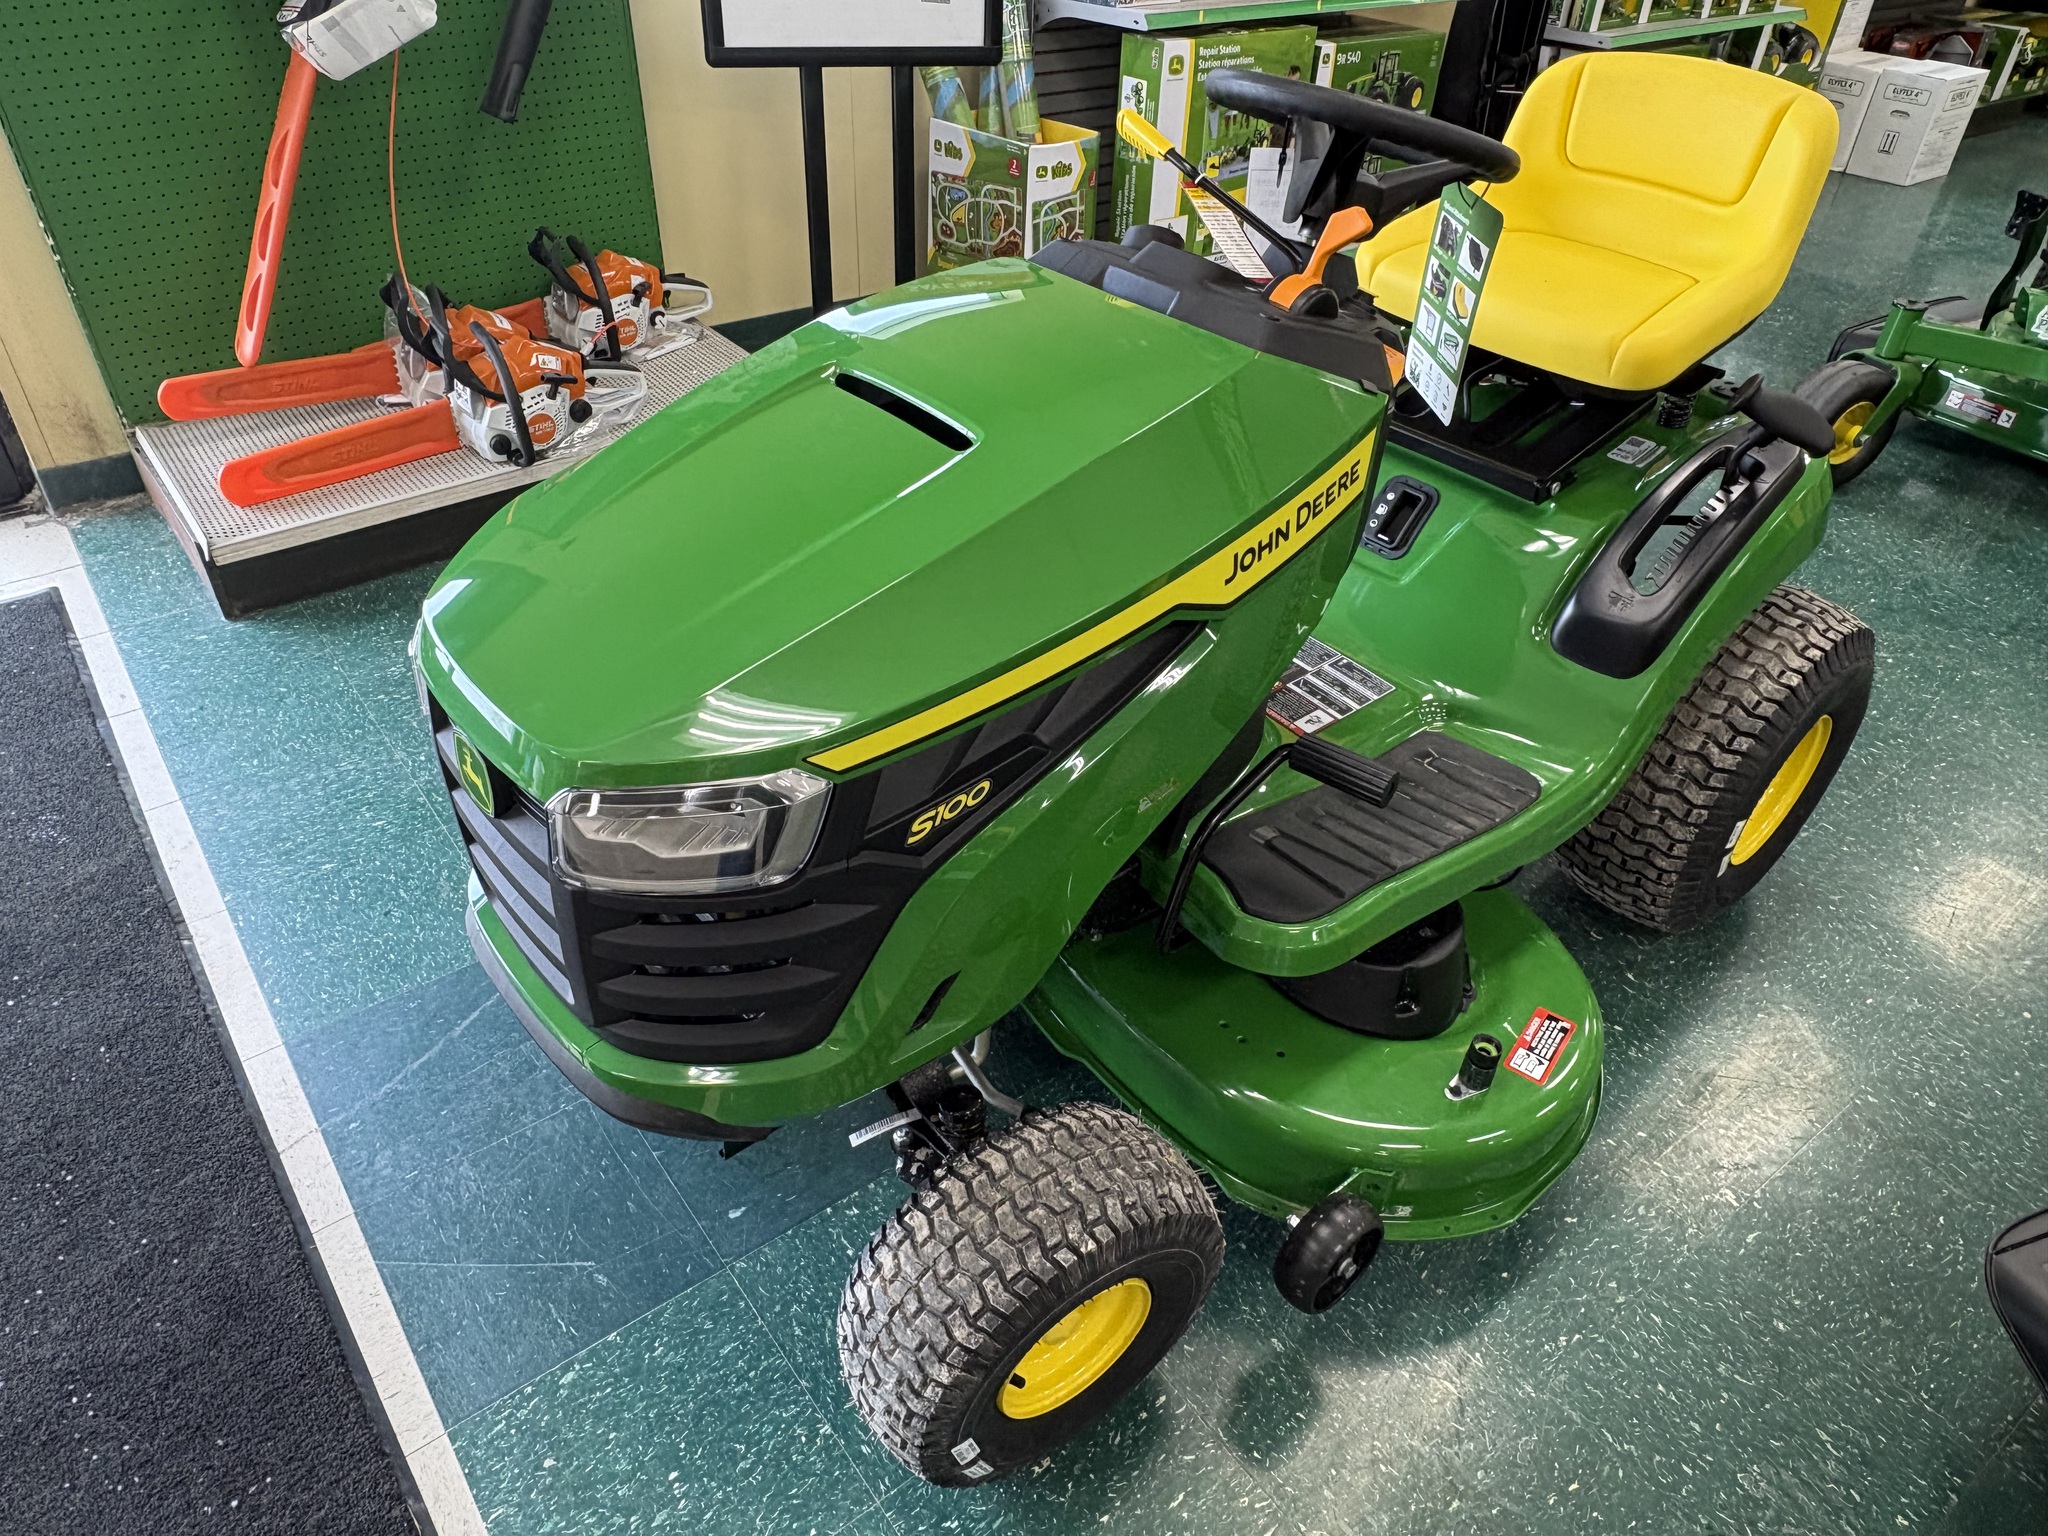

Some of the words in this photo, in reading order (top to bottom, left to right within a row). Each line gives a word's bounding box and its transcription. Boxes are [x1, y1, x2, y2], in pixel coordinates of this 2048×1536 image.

[1199, 46, 1219, 58] Repair
[1220, 44, 1241, 55] Station
[1347, 50, 1361, 64] 540
[1198, 59, 1221, 69] Station
[1221, 56, 1255, 68] réparations
[1224, 519, 1290, 586] JOHN
[1296, 458, 1361, 533] DEERE
[907, 780, 991, 844] S100
